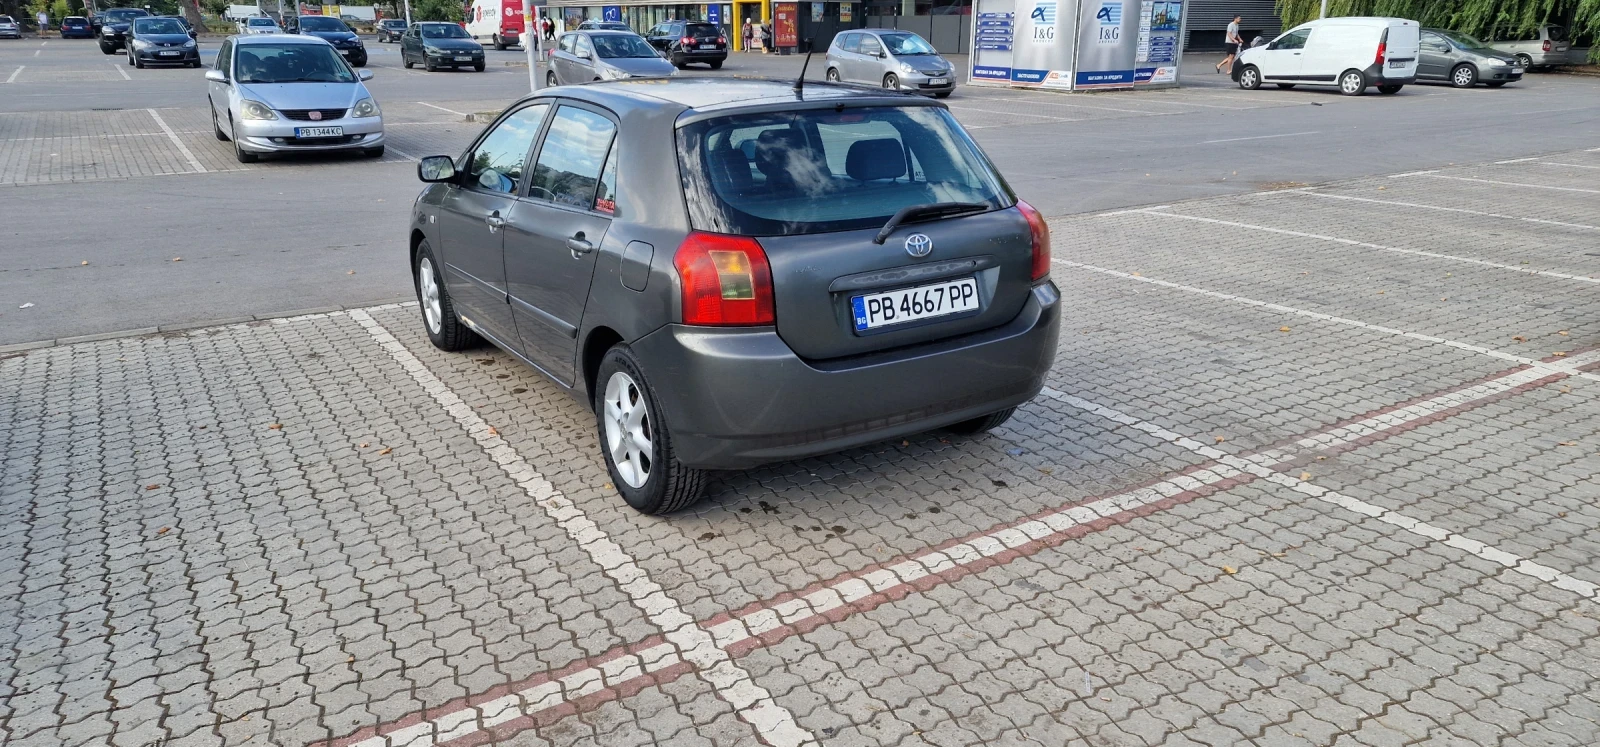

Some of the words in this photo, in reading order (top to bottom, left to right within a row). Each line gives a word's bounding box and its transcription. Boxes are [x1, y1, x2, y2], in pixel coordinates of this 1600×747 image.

[1034, 26, 1054, 40] I&G
[1100, 27, 1119, 40] I&G
[868, 296, 895, 323] PB
[900, 288, 944, 316] 4667
[949, 283, 973, 308] PP
